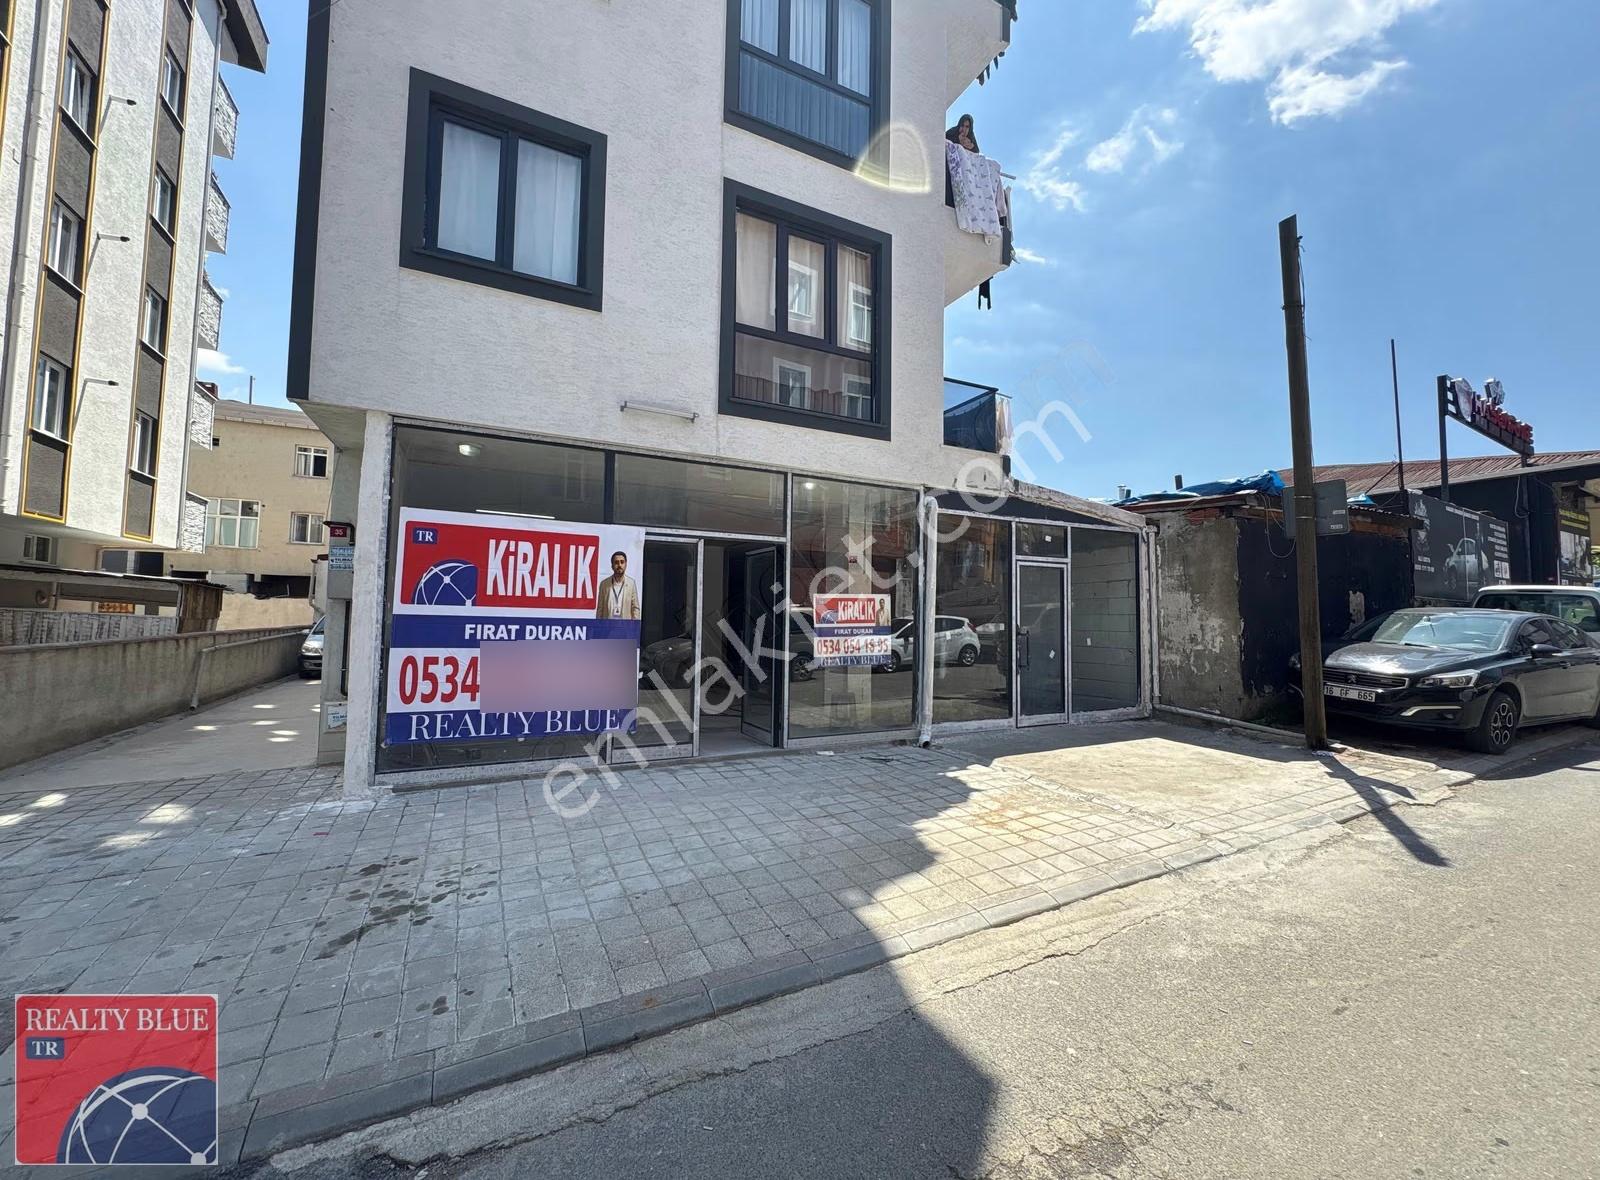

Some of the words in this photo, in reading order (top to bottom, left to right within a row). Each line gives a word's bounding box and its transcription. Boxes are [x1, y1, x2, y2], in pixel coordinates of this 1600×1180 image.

[416, 530, 434, 543] TR
[464, 624, 519, 640] FIRAT
[525, 625, 587, 641] DURAN
[399, 655, 480, 705] 0534
[408, 711, 536, 741] REALTY
[544, 709, 622, 734] BLUE
